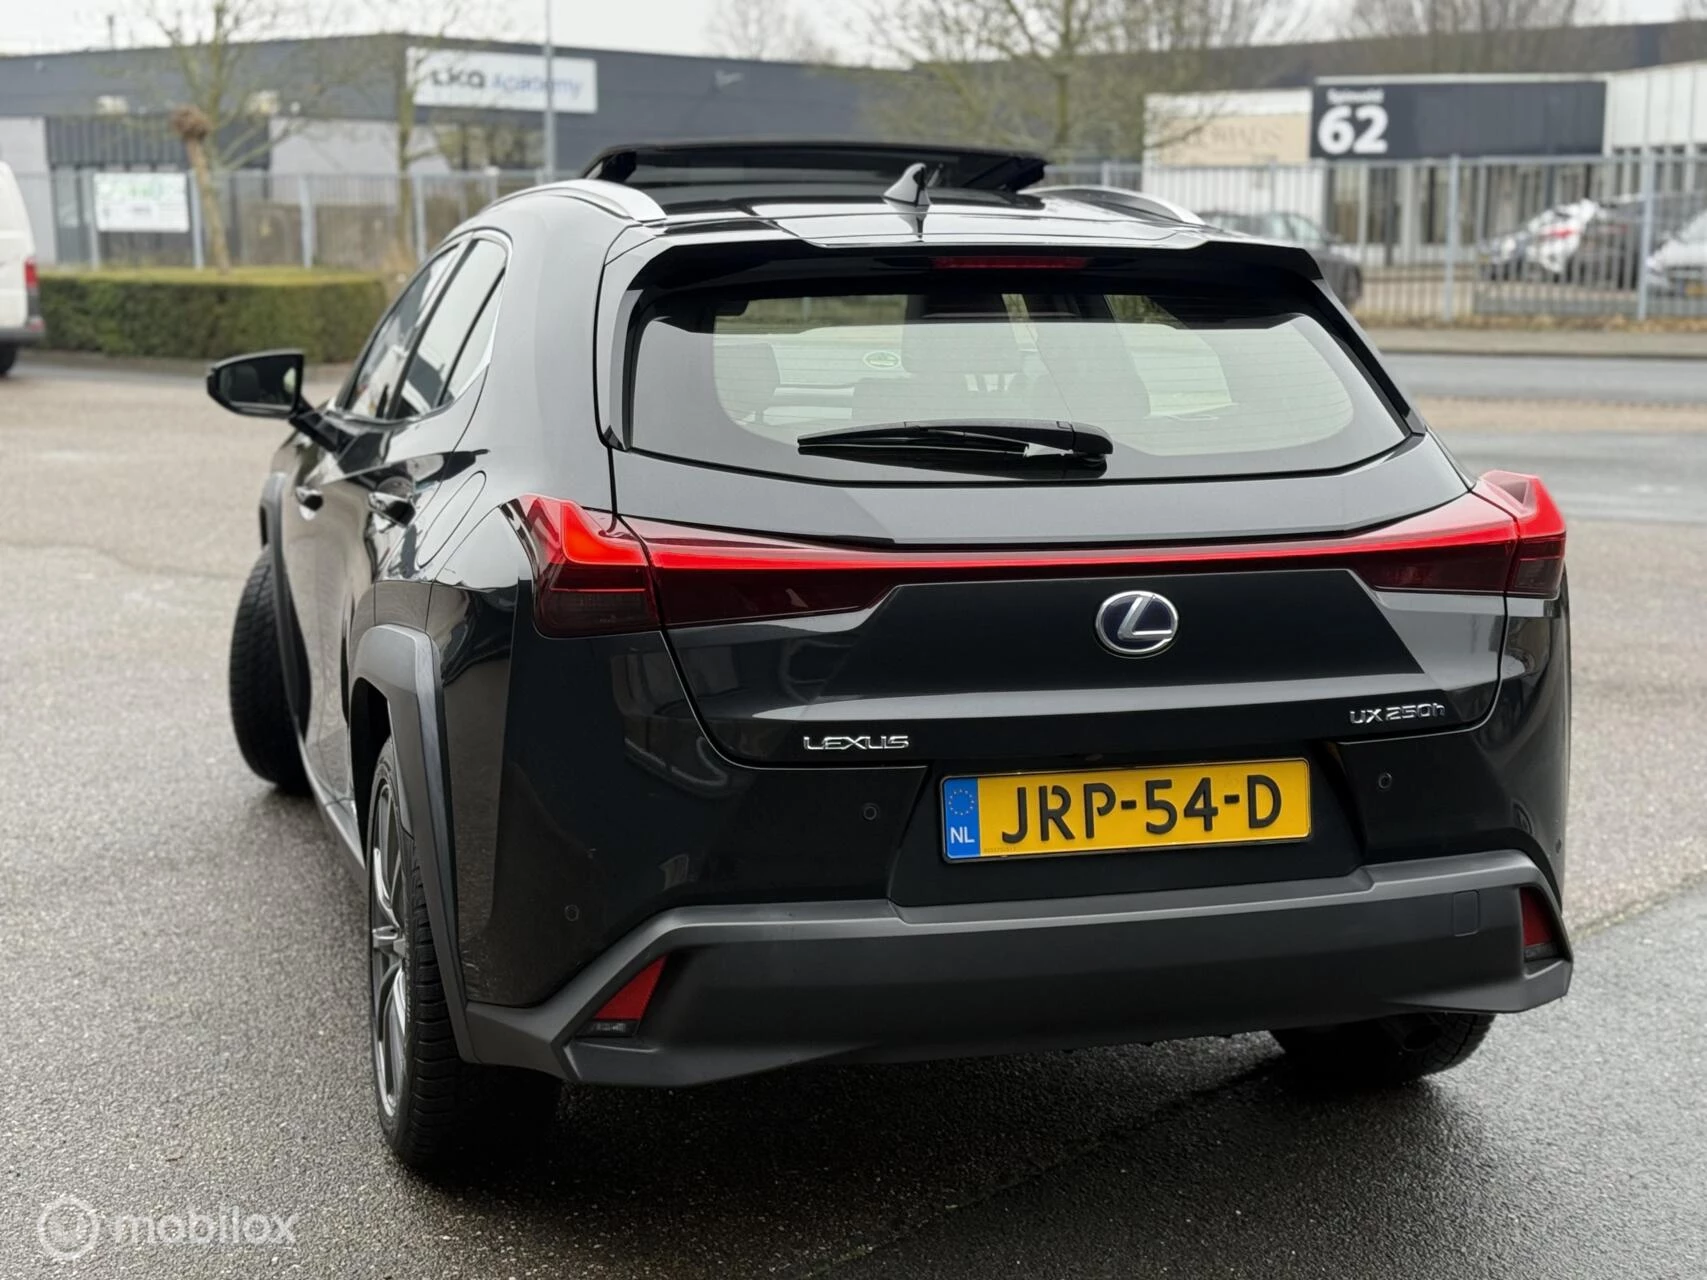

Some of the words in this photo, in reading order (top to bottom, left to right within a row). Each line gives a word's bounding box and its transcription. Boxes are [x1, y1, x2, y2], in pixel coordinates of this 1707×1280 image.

[490, 71, 583, 98] Acadmy
[1317, 104, 1389, 154] 62
[1349, 708, 1383, 724] UX
[1385, 702, 1446, 721] 250h
[803, 735, 909, 751] LEXUS
[1001, 774, 1283, 845] JRP-54-D
[950, 826, 976, 844] NL
